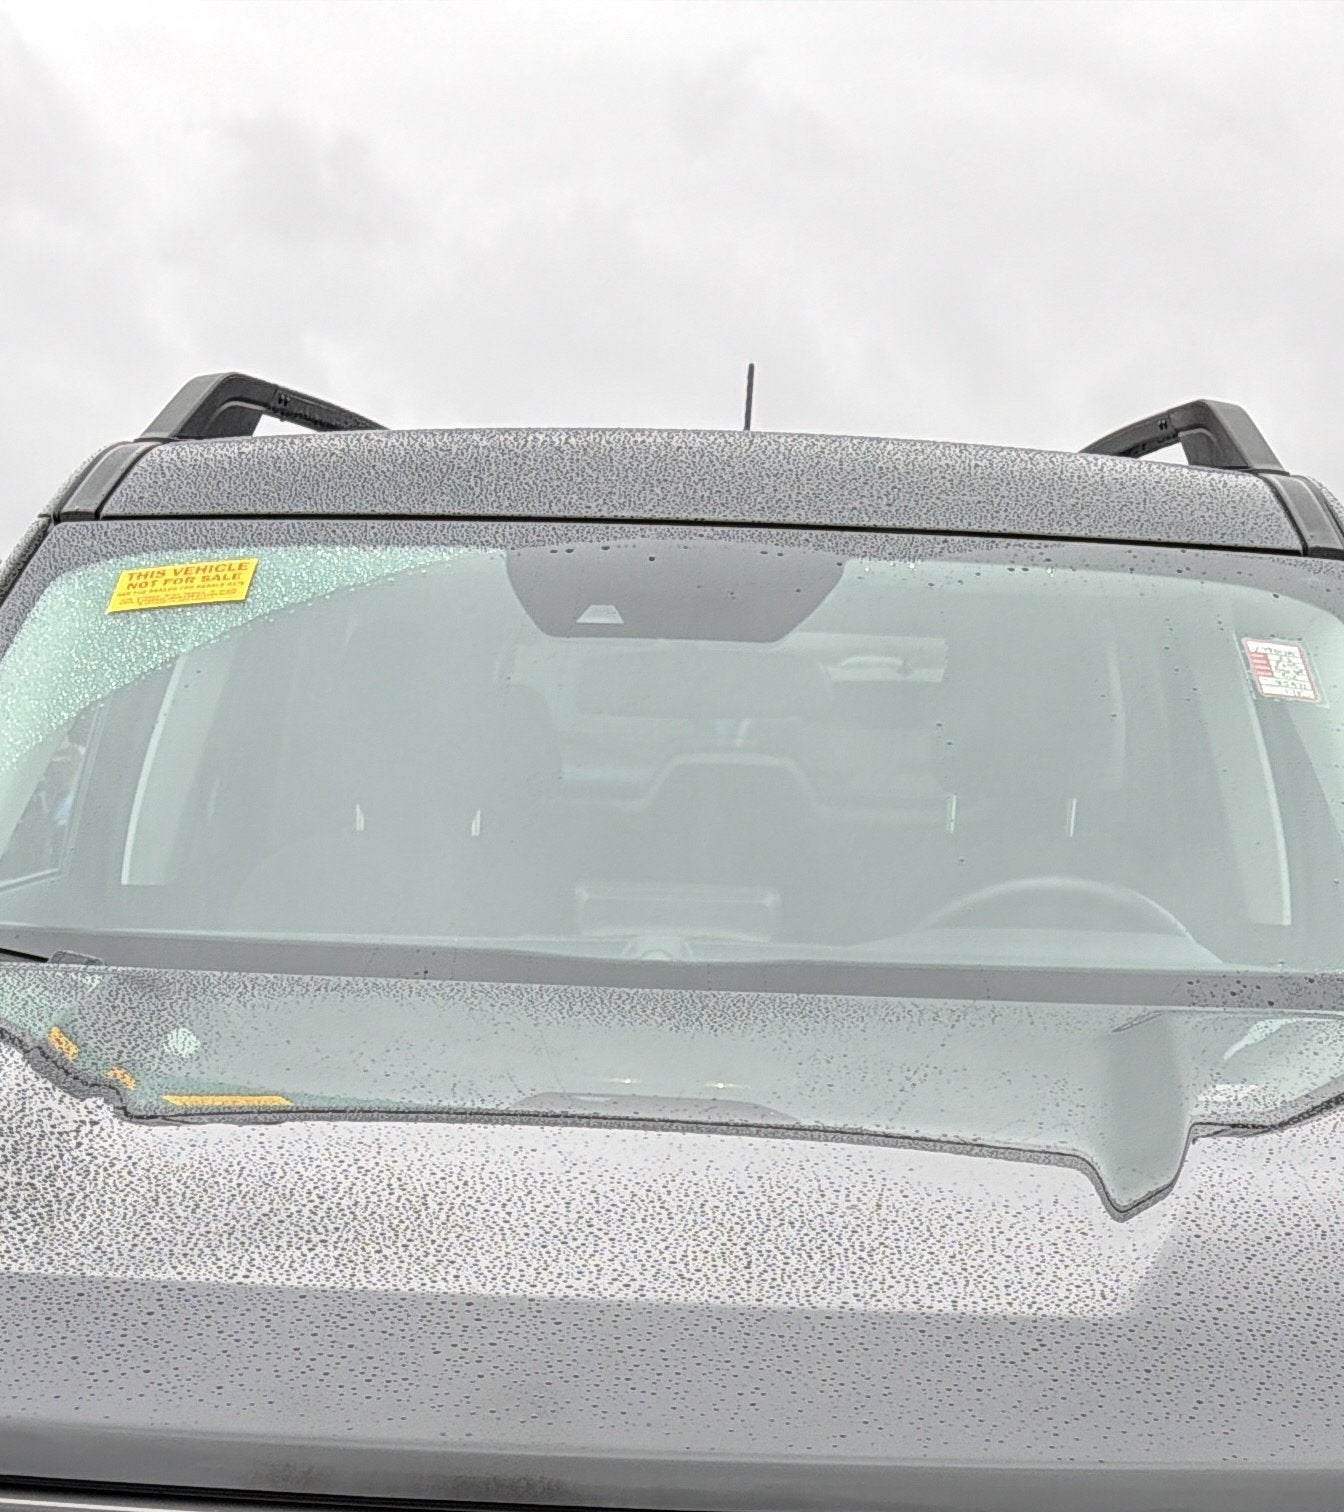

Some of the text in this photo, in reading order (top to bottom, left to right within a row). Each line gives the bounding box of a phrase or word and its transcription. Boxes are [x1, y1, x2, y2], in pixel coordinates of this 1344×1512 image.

[127, 562, 250, 581] THIS VEHICLE
[127, 573, 243, 591] NOT FOR SALE
